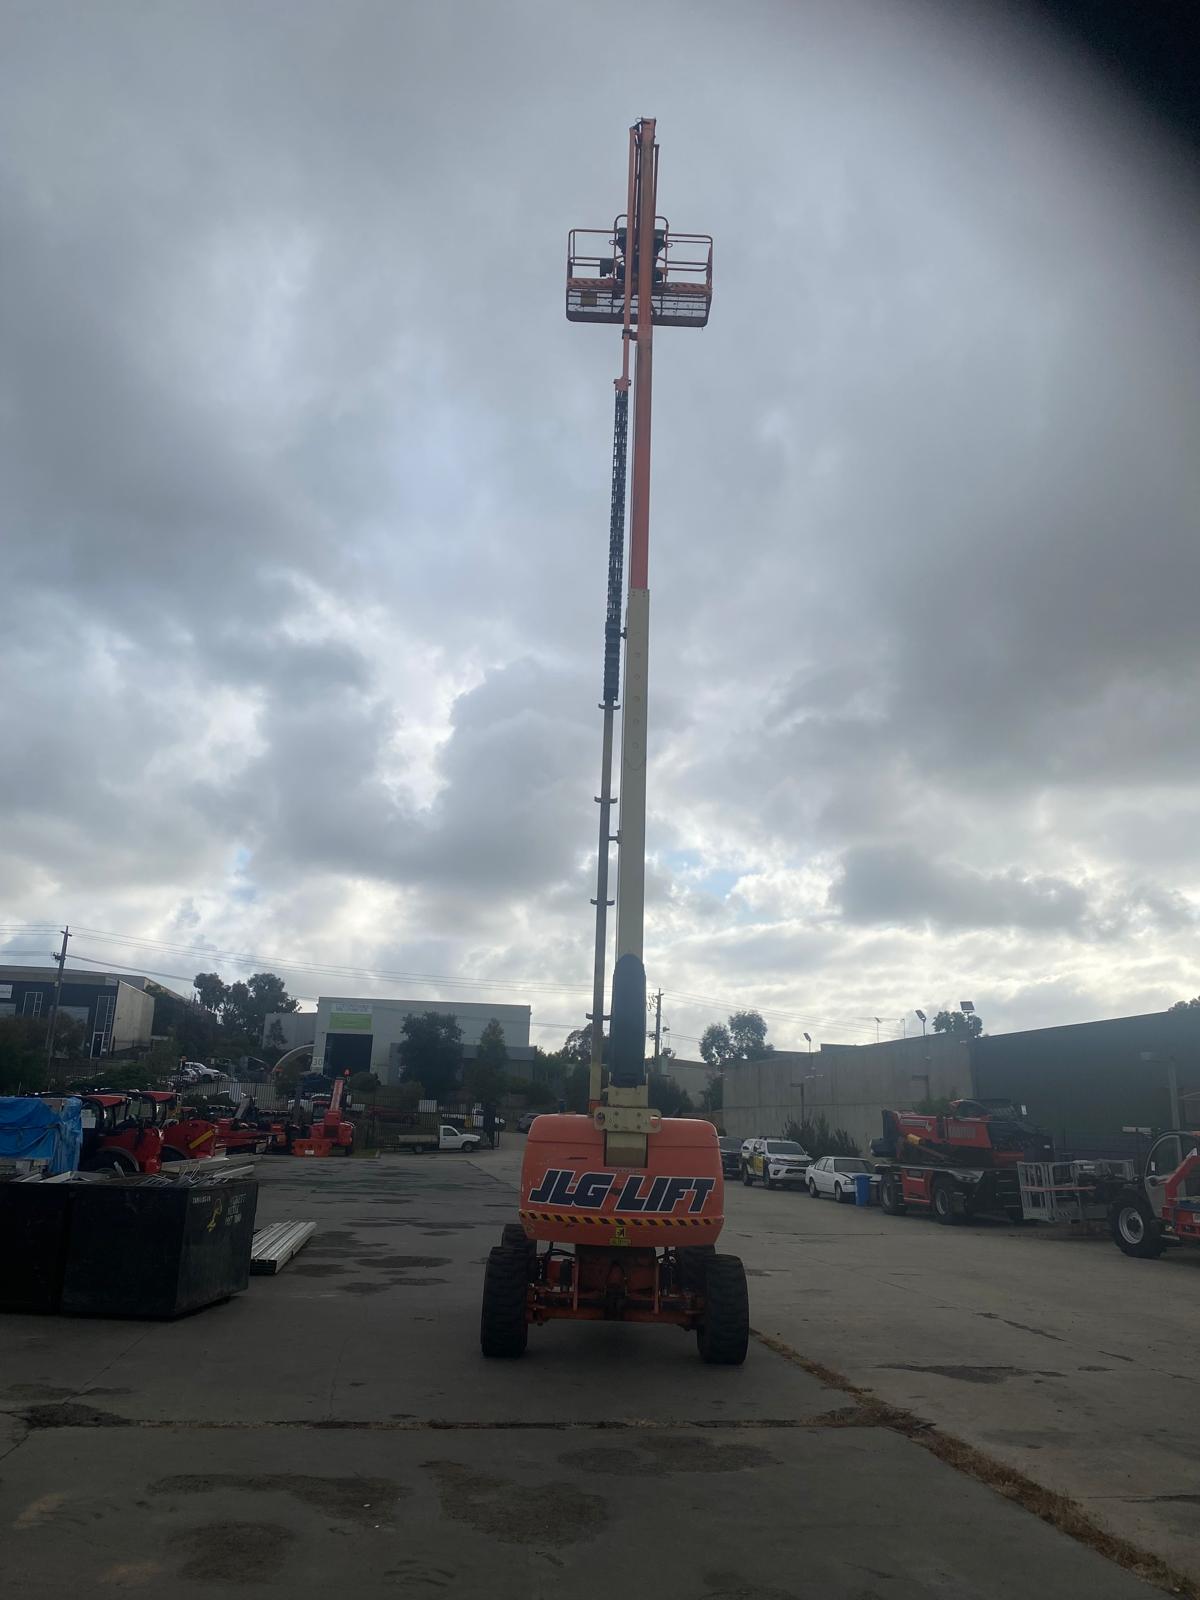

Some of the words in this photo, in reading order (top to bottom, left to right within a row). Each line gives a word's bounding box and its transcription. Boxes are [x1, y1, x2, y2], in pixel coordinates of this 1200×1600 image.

[313, 1058, 322, 1066] 30
[528, 1168, 615, 1210] JLG
[614, 1175, 716, 1213] LIFT
